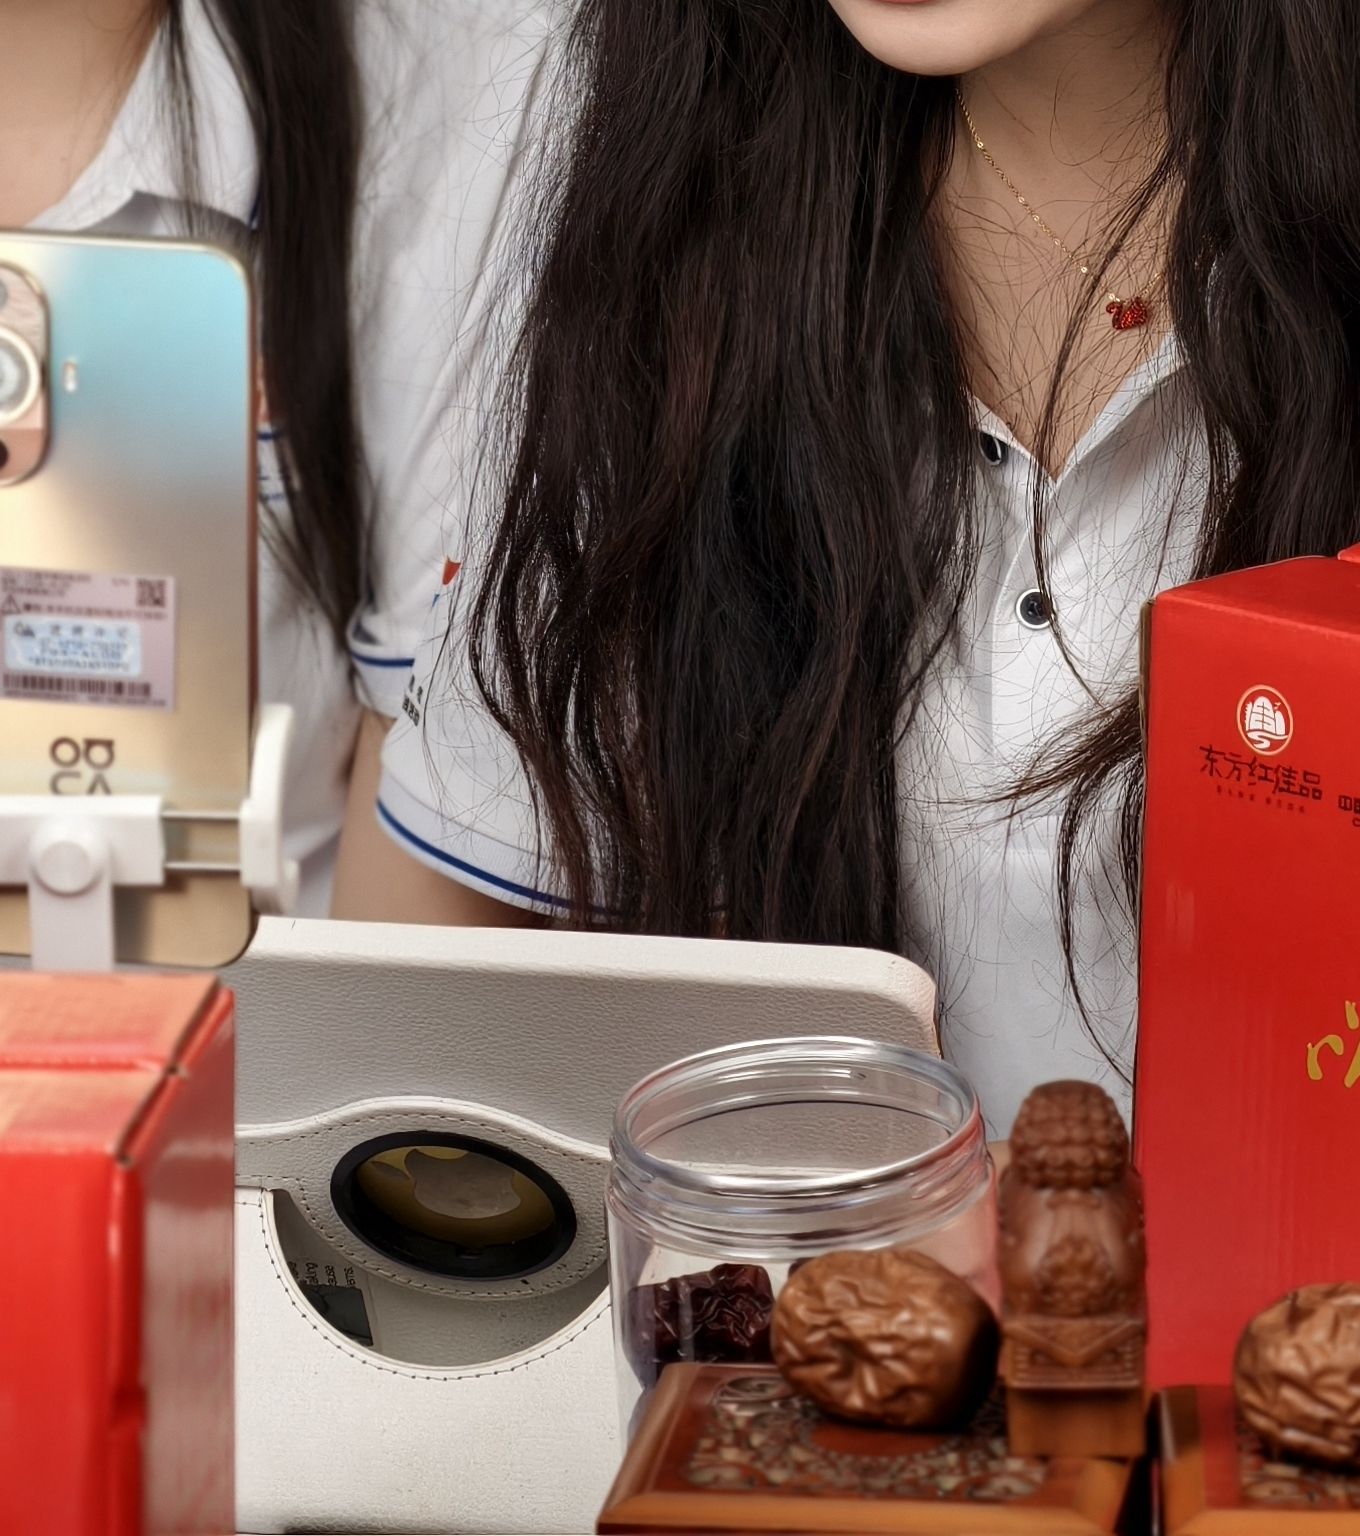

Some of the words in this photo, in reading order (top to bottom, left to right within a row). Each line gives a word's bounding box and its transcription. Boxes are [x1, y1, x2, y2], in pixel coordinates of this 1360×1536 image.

[1199, 744, 1323, 801] 东方红佳品
